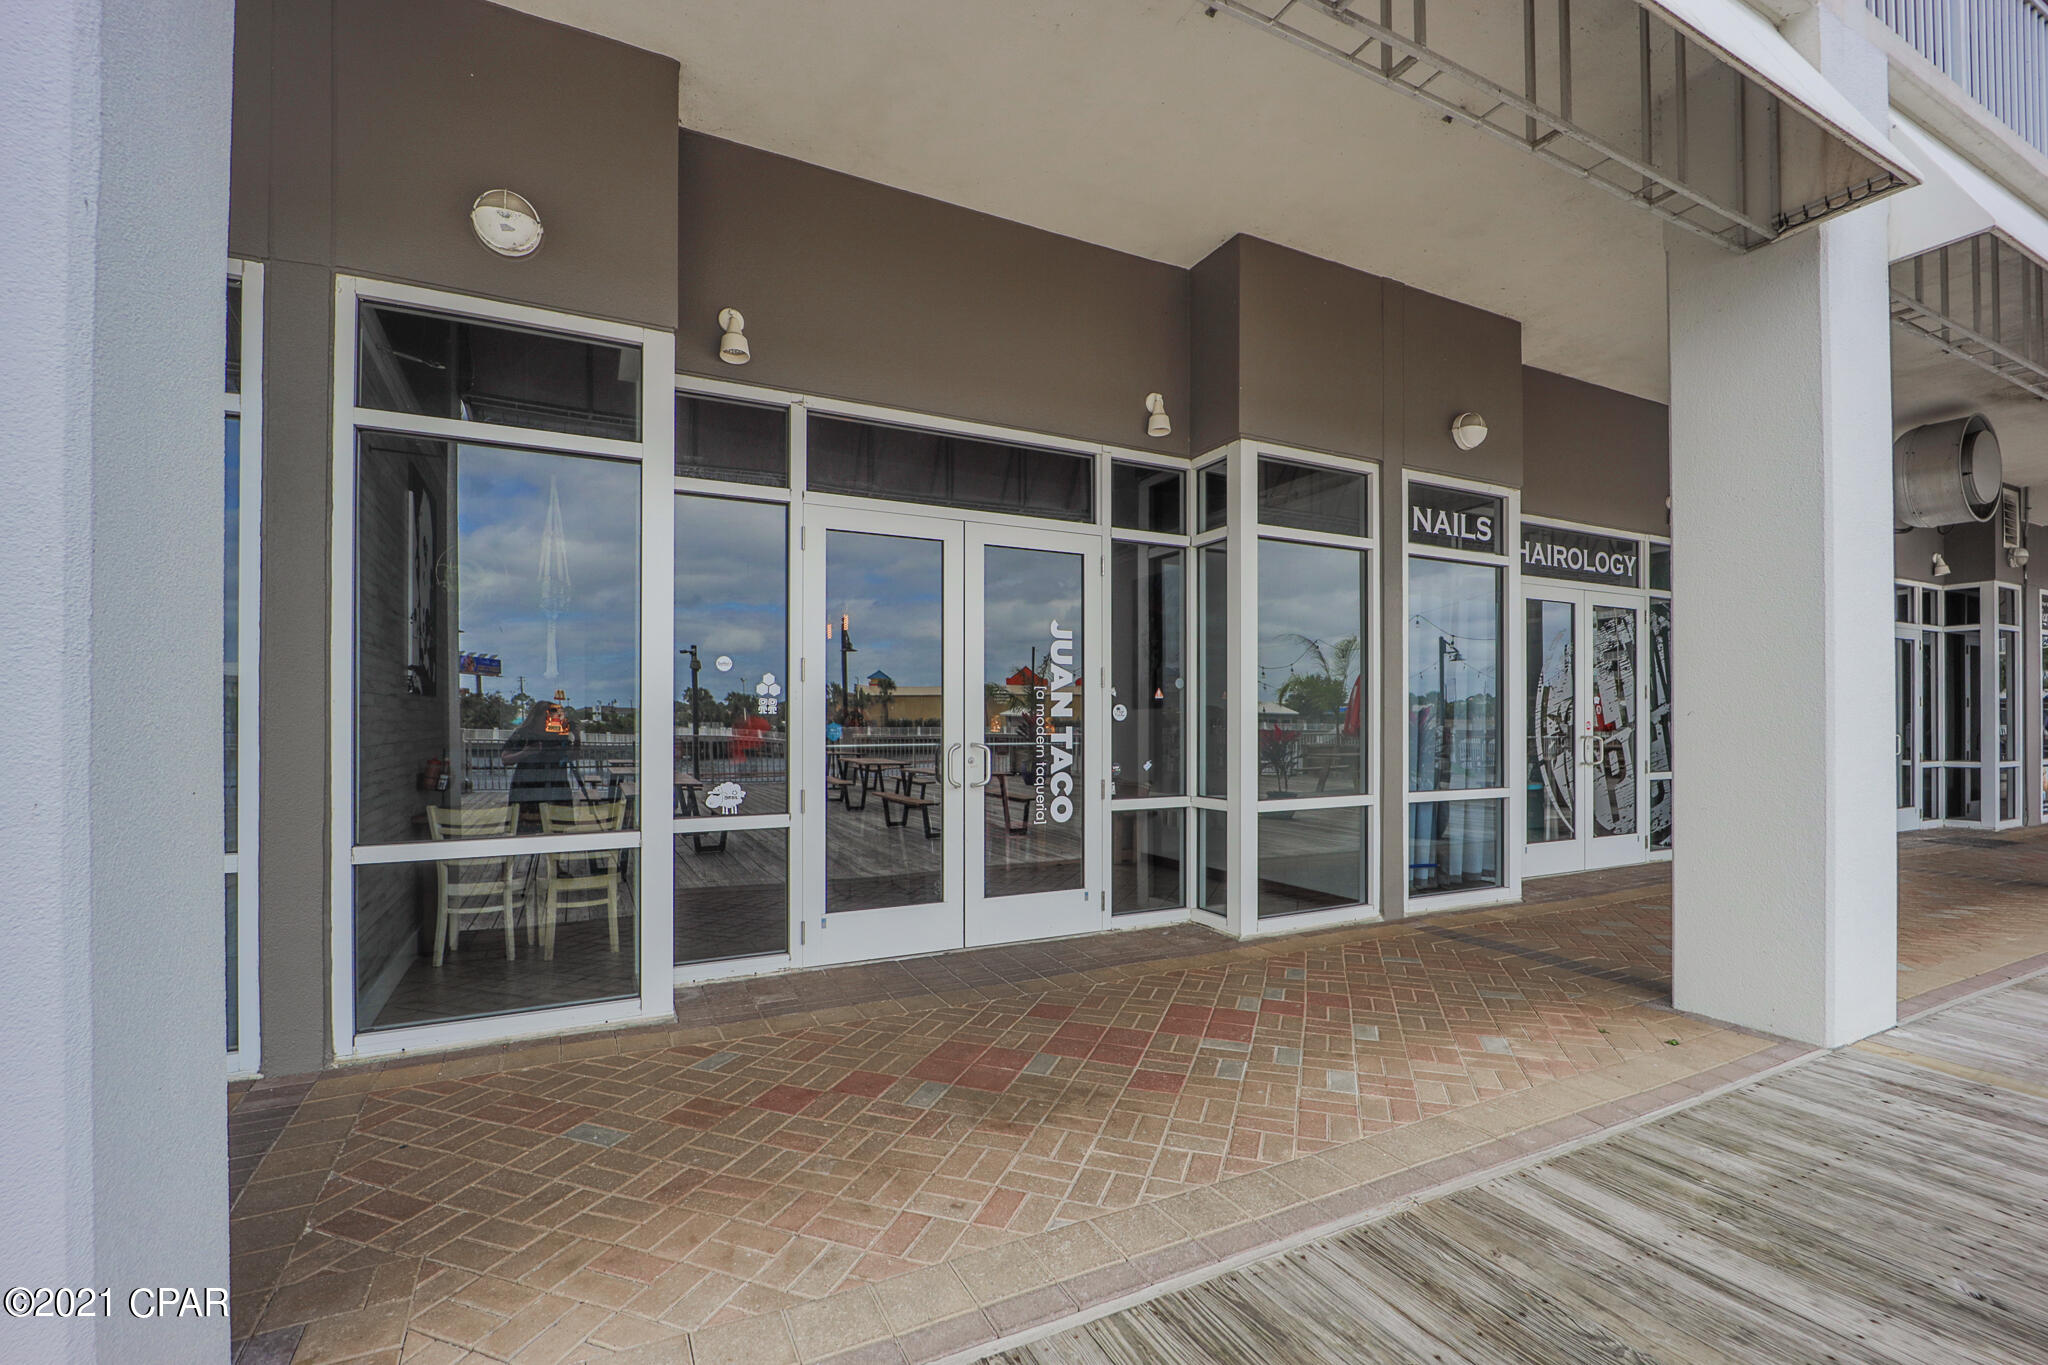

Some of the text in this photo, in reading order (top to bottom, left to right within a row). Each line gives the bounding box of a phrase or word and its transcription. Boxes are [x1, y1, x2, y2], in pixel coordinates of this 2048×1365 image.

[1412, 505, 1492, 541] NAILS
[1520, 541, 1637, 577] HAIROLOGY
[1035, 703, 1047, 758] modern
[1050, 619, 1074, 823] JUAN TACO
